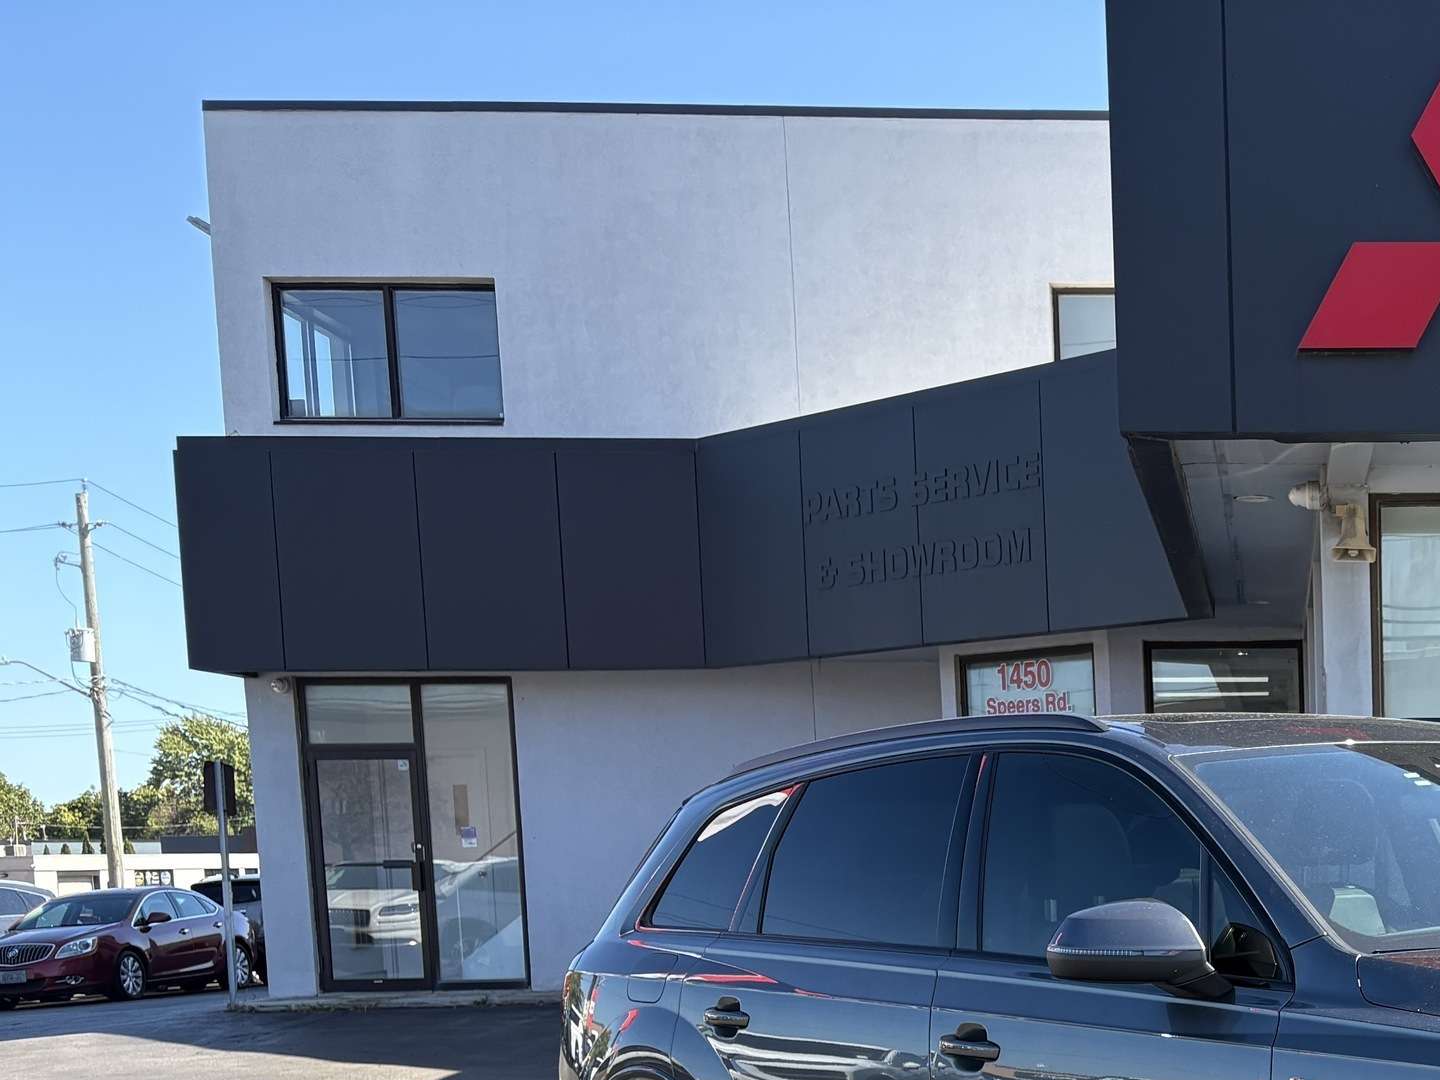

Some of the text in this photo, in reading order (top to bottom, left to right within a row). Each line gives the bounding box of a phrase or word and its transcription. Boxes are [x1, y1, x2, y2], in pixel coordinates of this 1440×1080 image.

[804, 452, 1042, 525] PARTS SERVICE
[817, 527, 1033, 591] & SHOWROOM
[996, 659, 1052, 692] 1450
[986, 690, 1073, 716] Speers Rd.
